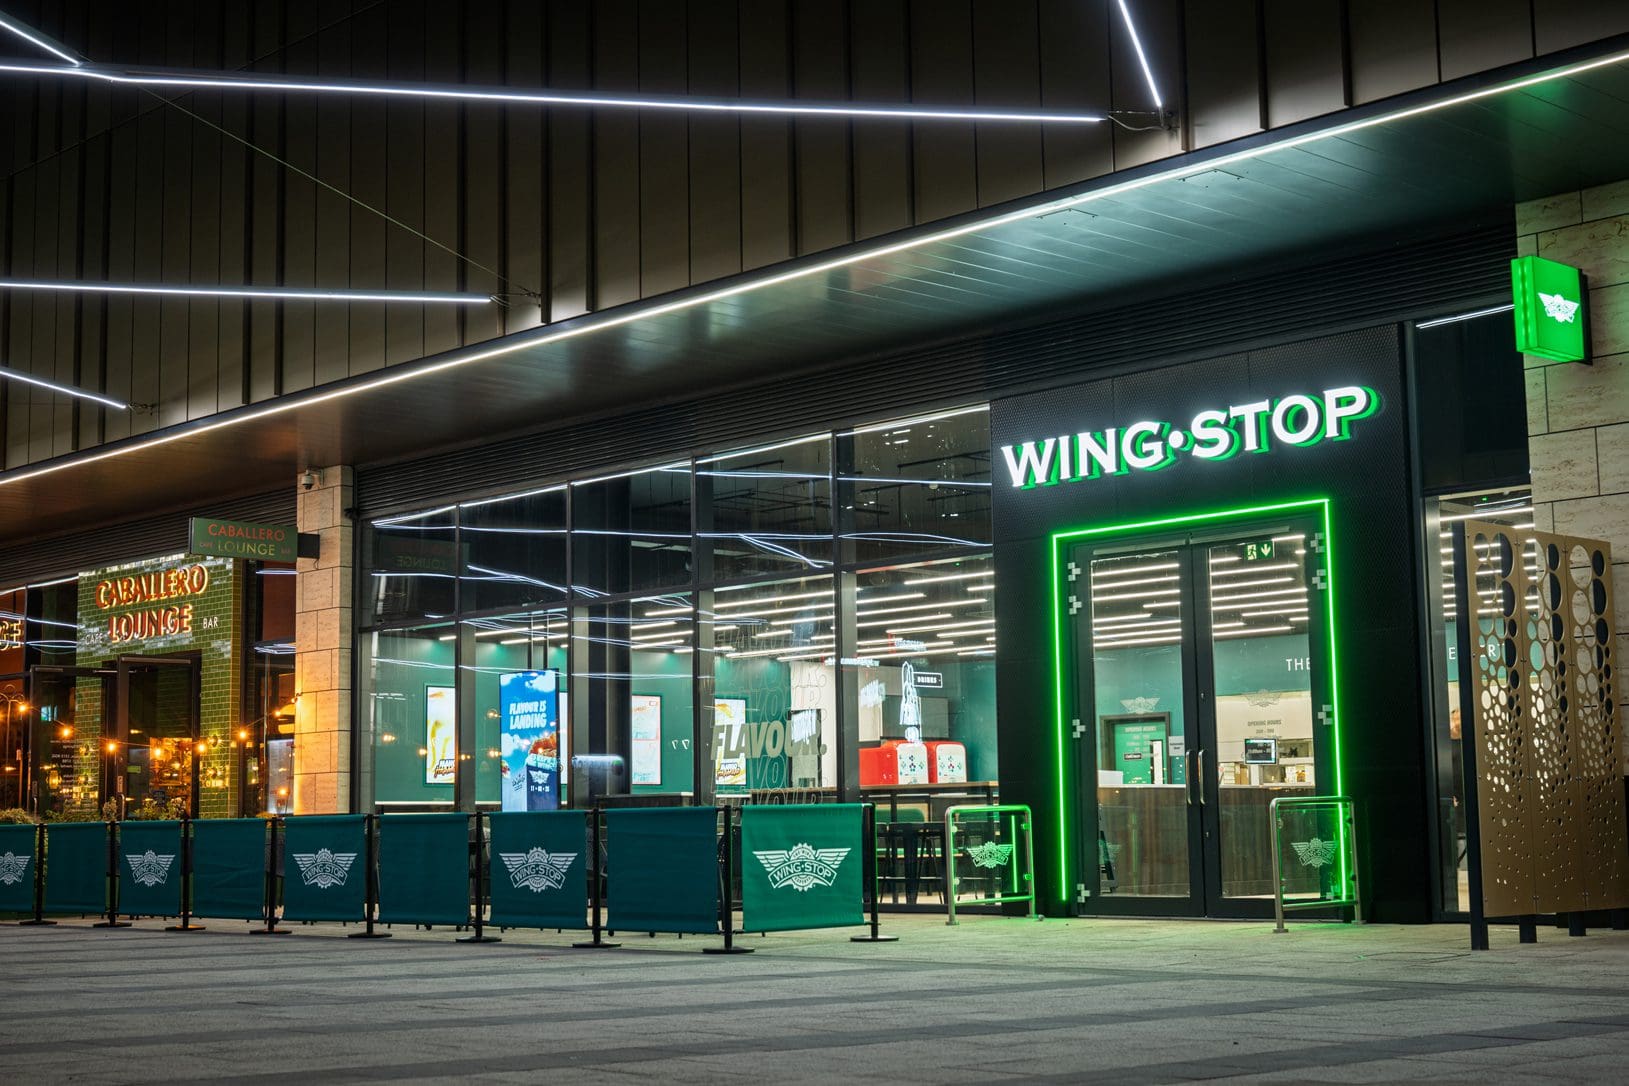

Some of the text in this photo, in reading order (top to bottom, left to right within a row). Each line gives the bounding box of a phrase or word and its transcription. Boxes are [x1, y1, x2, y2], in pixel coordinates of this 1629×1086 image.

[208, 523, 285, 542] CABALLERO
[218, 541, 275, 556] LOUNGE
[95, 563, 208, 610] CABALLERO
[108, 603, 193, 644] LOUNGE
[202, 616, 219, 629] BAR
[509, 699, 547, 715] FLAVOUR IS
[509, 712, 547, 730] LANDING
